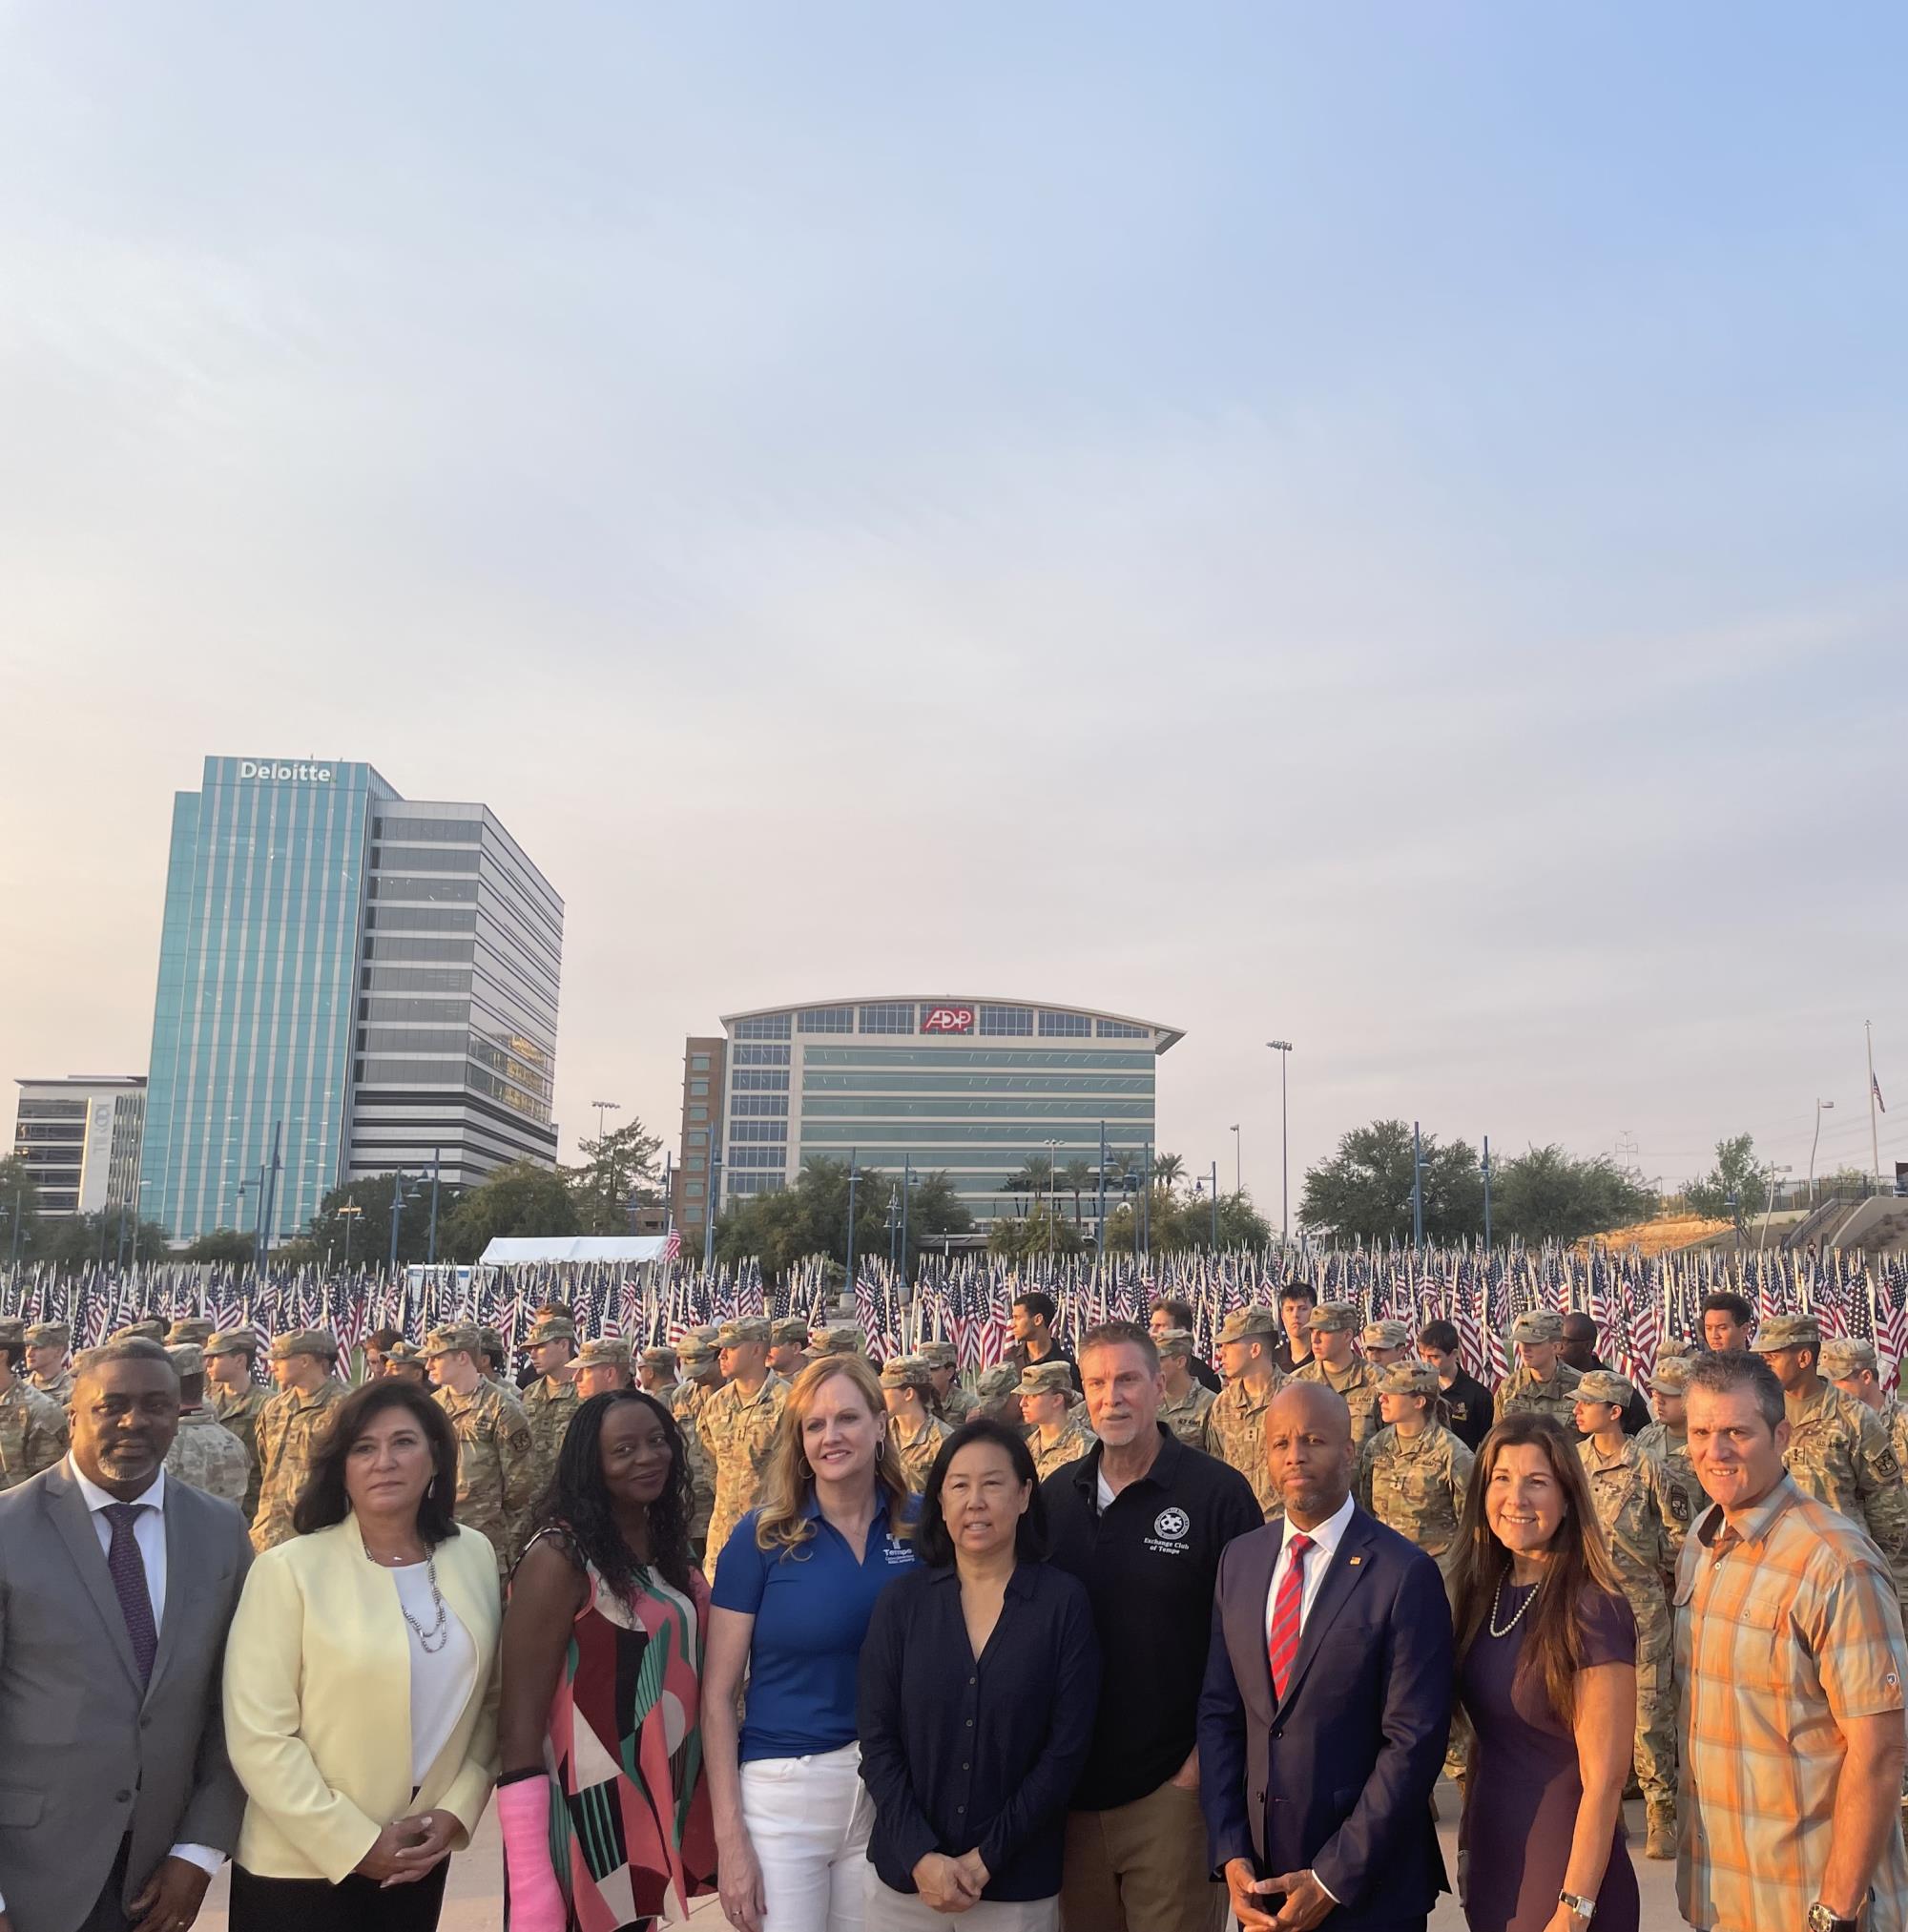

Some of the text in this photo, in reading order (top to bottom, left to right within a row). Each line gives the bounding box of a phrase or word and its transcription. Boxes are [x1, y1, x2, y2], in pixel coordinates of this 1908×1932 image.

[240, 761, 331, 782] Deloitte
[925, 1010, 971, 1028] ADP
[1144, 1537, 1190, 1550] Exchange Club
[1158, 1546, 1180, 1554] Tempe
